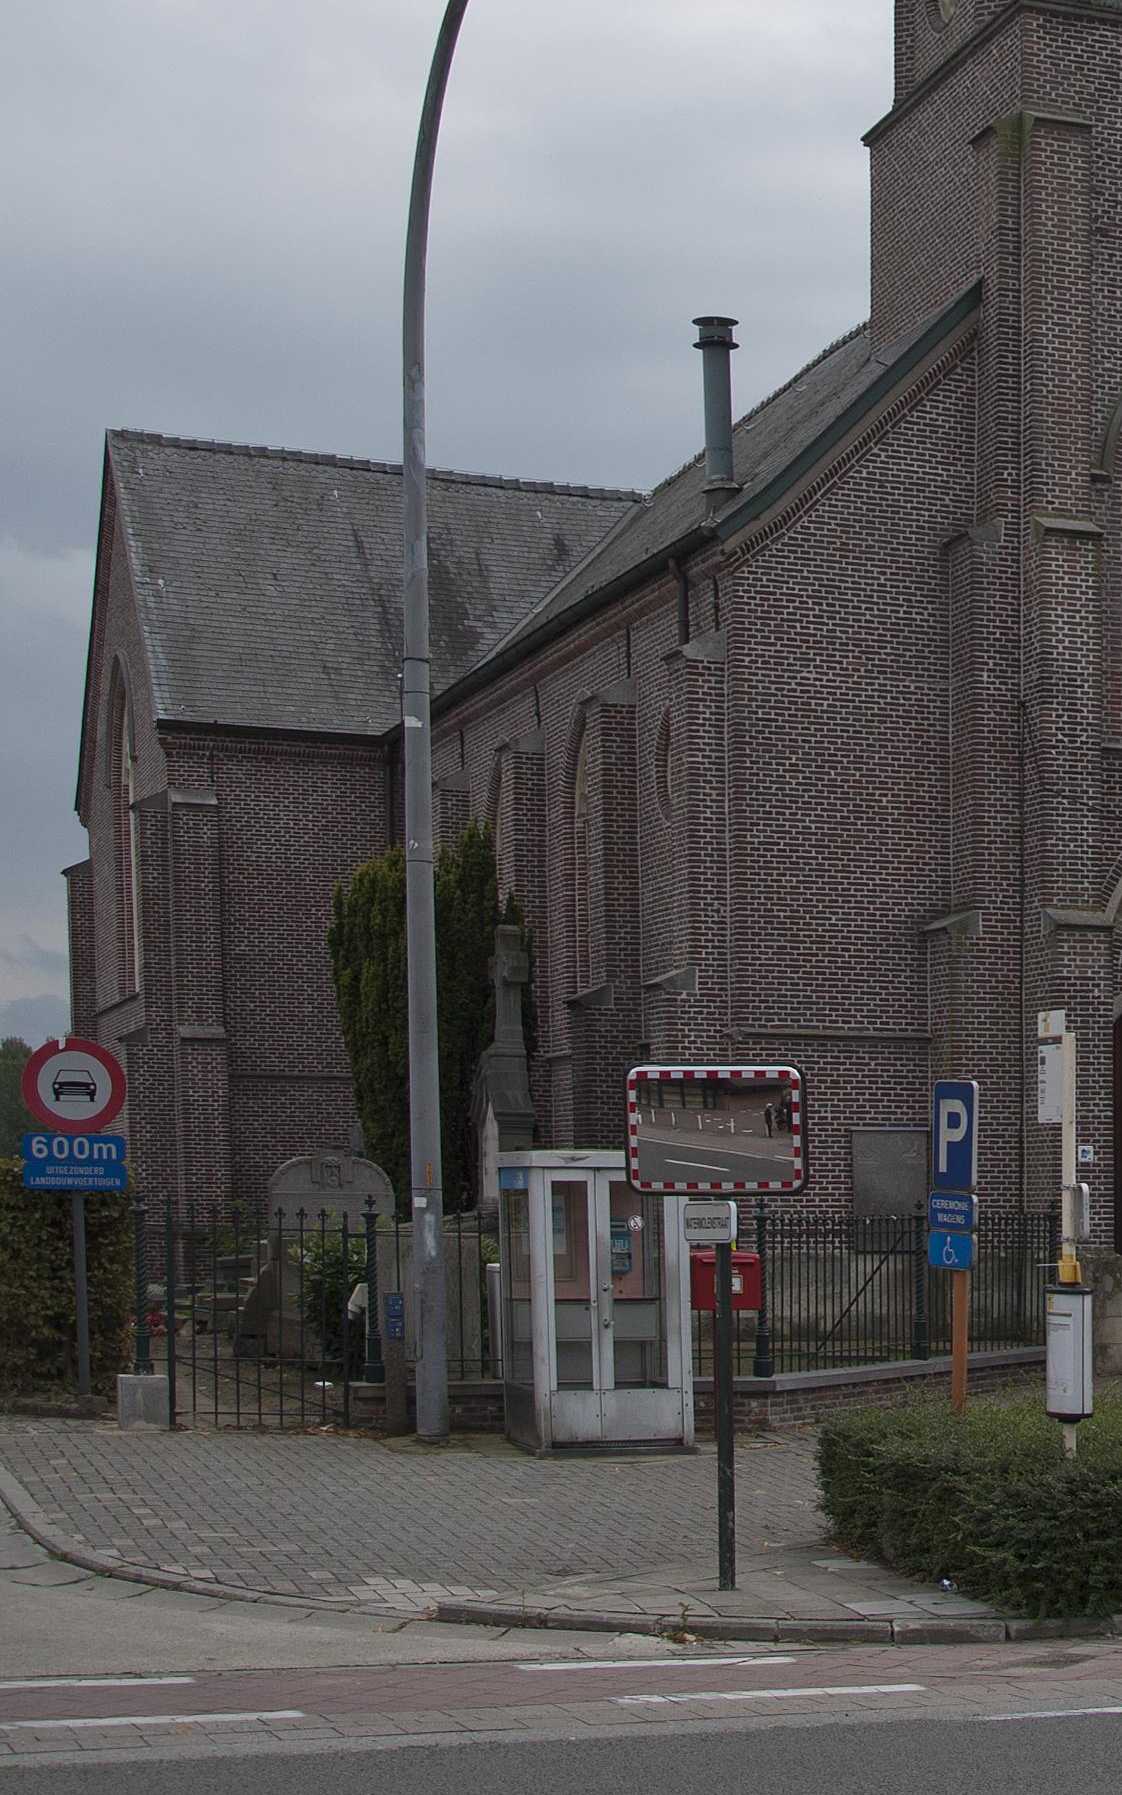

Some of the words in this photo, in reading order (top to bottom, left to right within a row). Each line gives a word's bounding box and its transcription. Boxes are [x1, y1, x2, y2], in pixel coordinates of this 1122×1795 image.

[939, 1099, 968, 1172] P
[31, 1136, 117, 1159] 600m
[46, 1166, 104, 1175] UITGEZONDERD
[30, 1176, 120, 1186] LANDBOUWVOERTUIGEN
[937, 1212, 965, 1224] WAGENS
